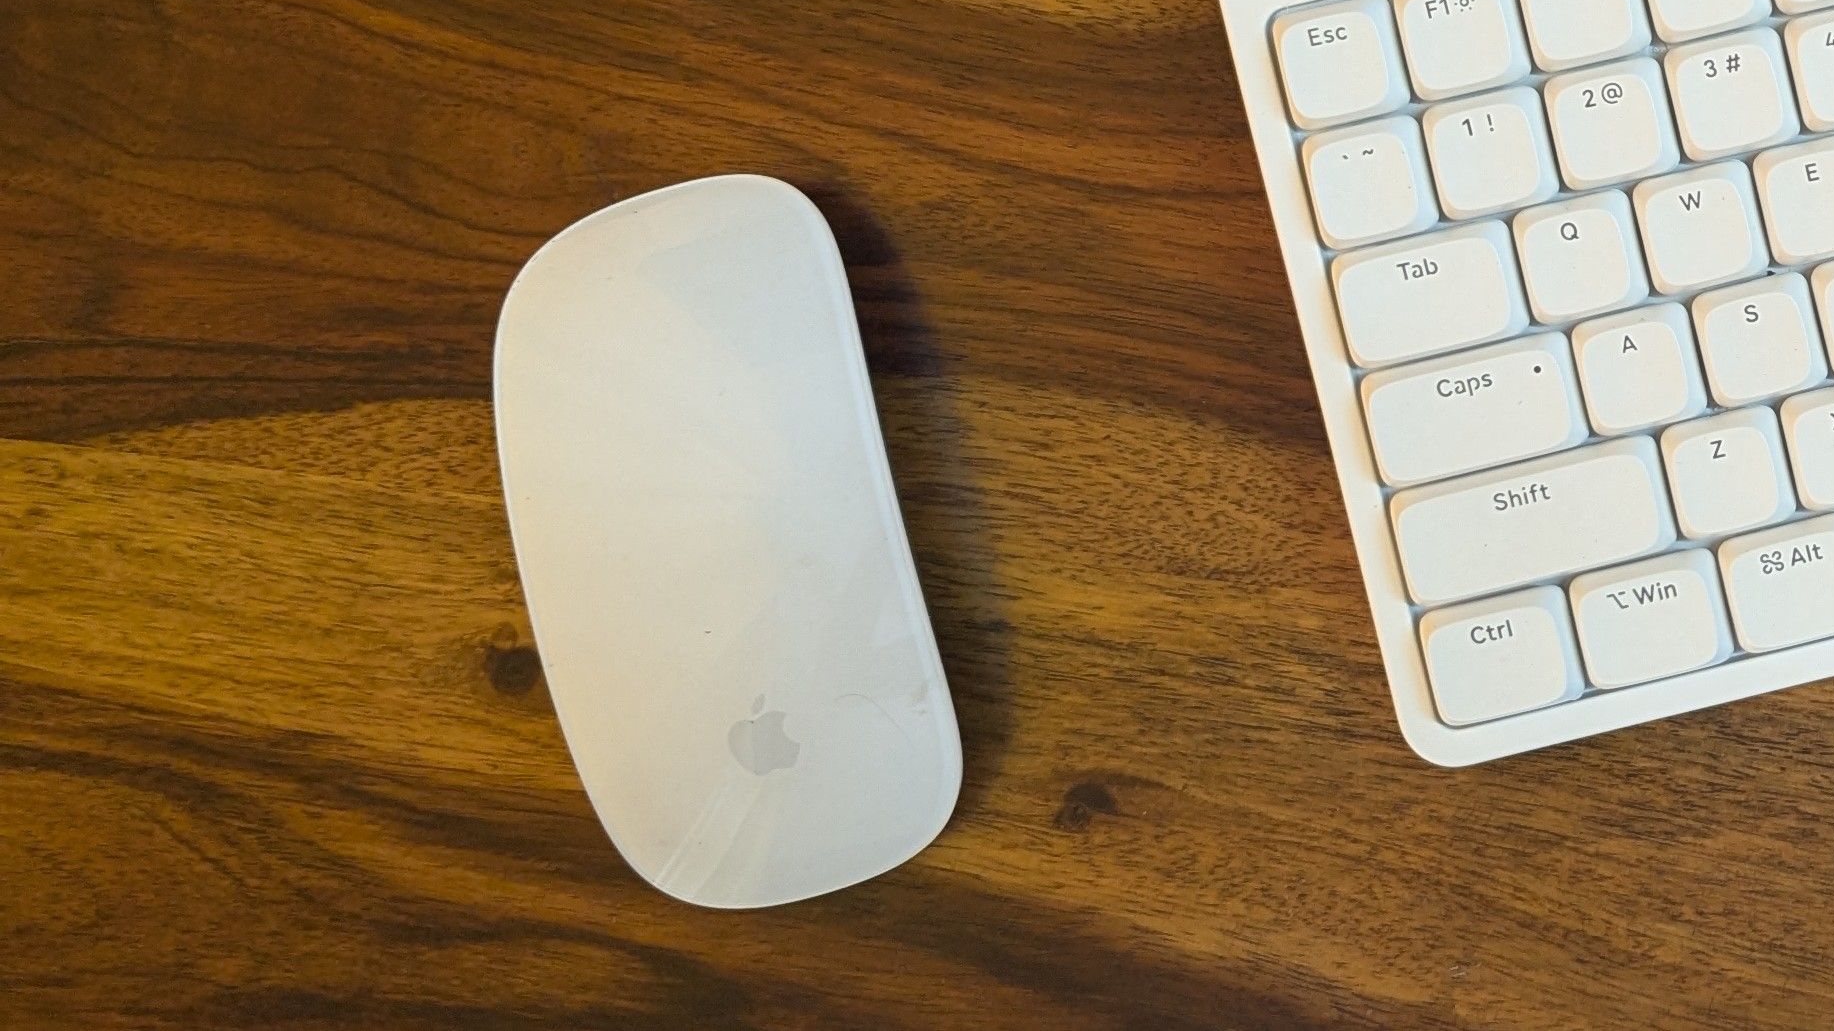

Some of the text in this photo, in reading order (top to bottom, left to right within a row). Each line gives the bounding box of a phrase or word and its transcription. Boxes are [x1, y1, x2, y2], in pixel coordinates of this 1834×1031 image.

[1306, 26, 1348, 47] Esc
[1703, 53, 1741, 79] 3 #
[1461, 117, 1474, 137] 1
[1804, 162, 1821, 183] E
[1678, 190, 1702, 212] W
[1559, 221, 1580, 242] Q
[1395, 257, 1439, 281] Tab
[1743, 303, 1760, 324] S
[1622, 334, 1638, 354] A
[1435, 373, 1494, 398] Caps
[1709, 439, 1727, 460] Z
[1492, 483, 1552, 512] Shift
[1790, 543, 1824, 567] Alt
[1631, 581, 1678, 606] Win
[1469, 619, 1514, 645] Ctrl
